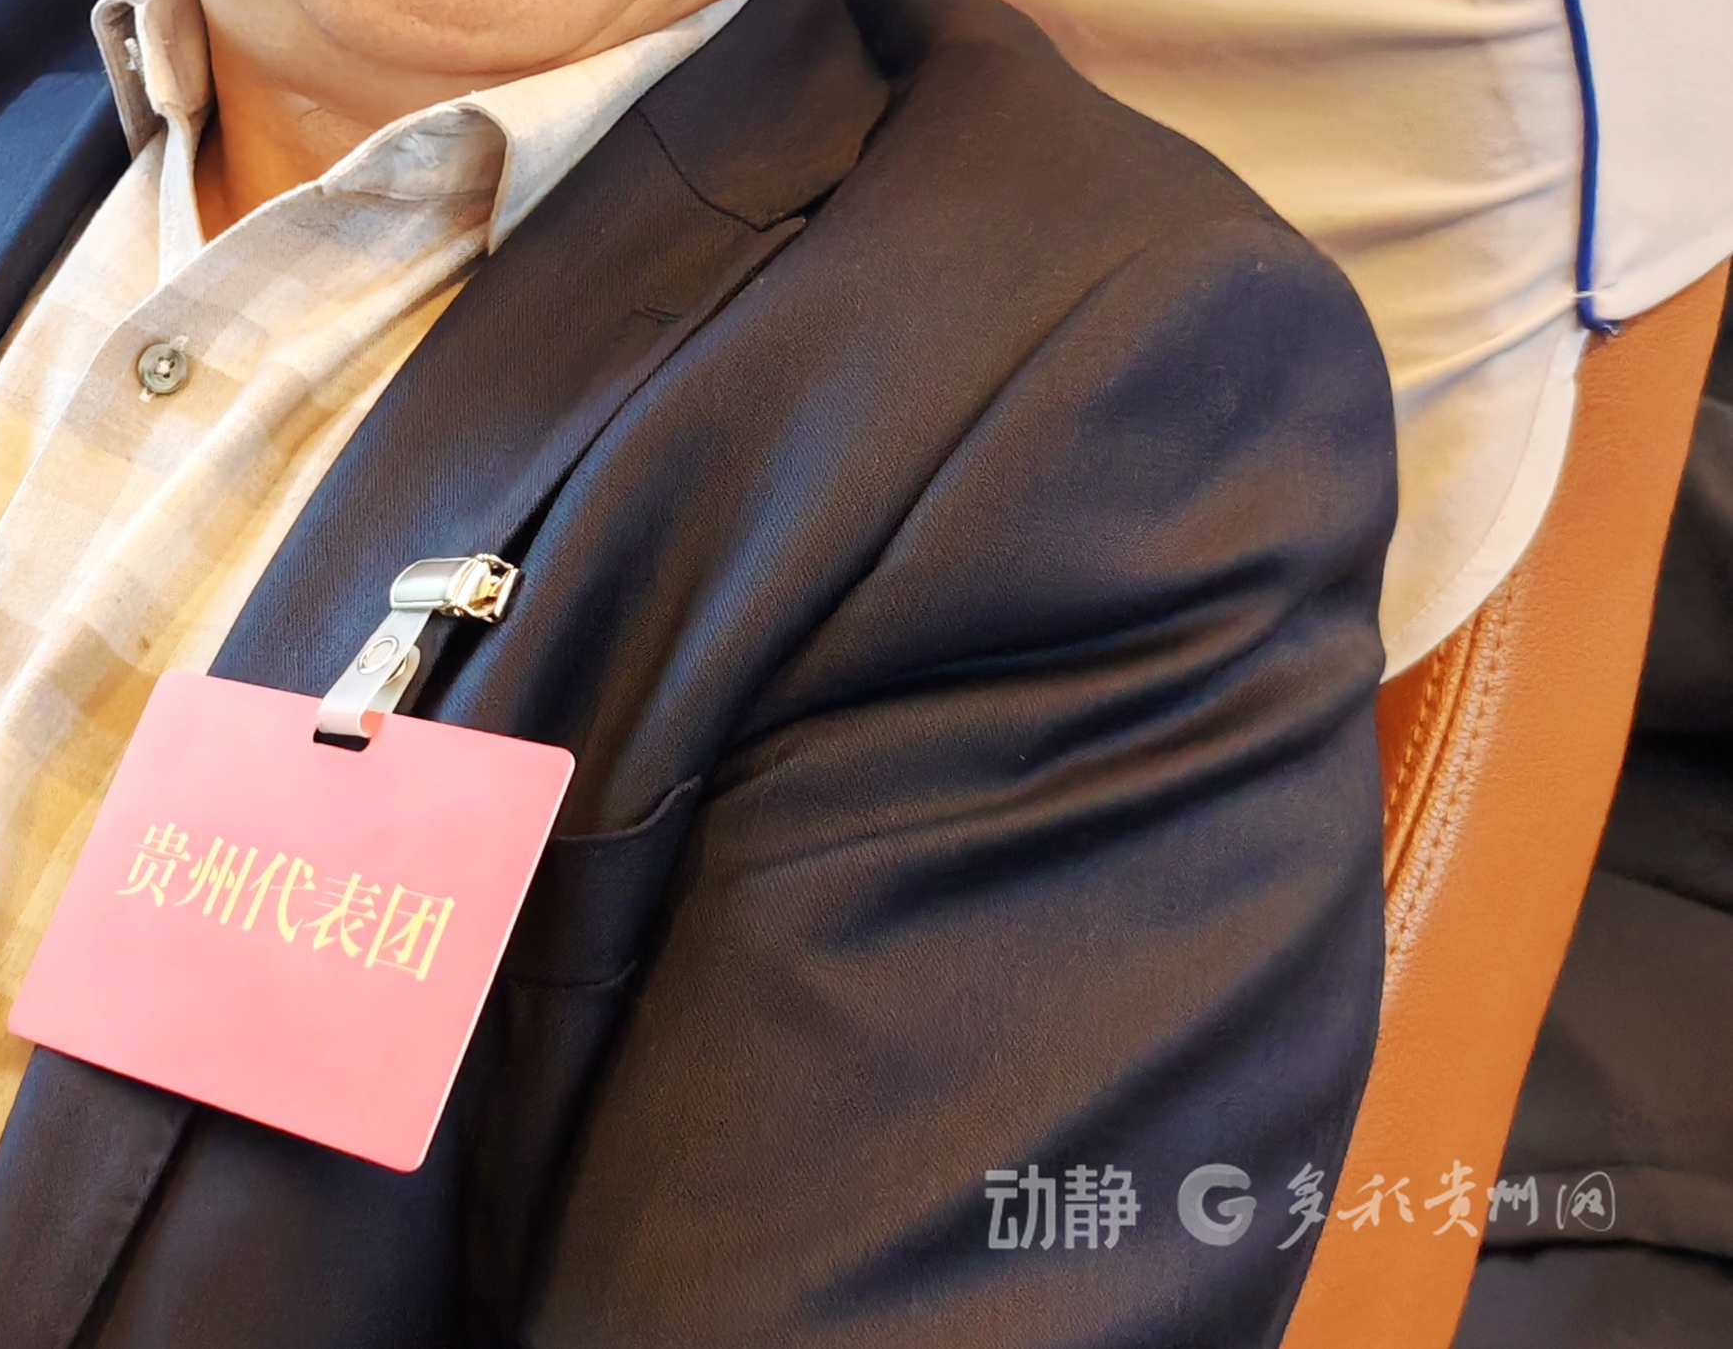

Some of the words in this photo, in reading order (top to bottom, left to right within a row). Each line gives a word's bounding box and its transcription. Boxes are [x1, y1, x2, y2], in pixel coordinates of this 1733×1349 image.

[115, 821, 457, 982] 贵州代表团
